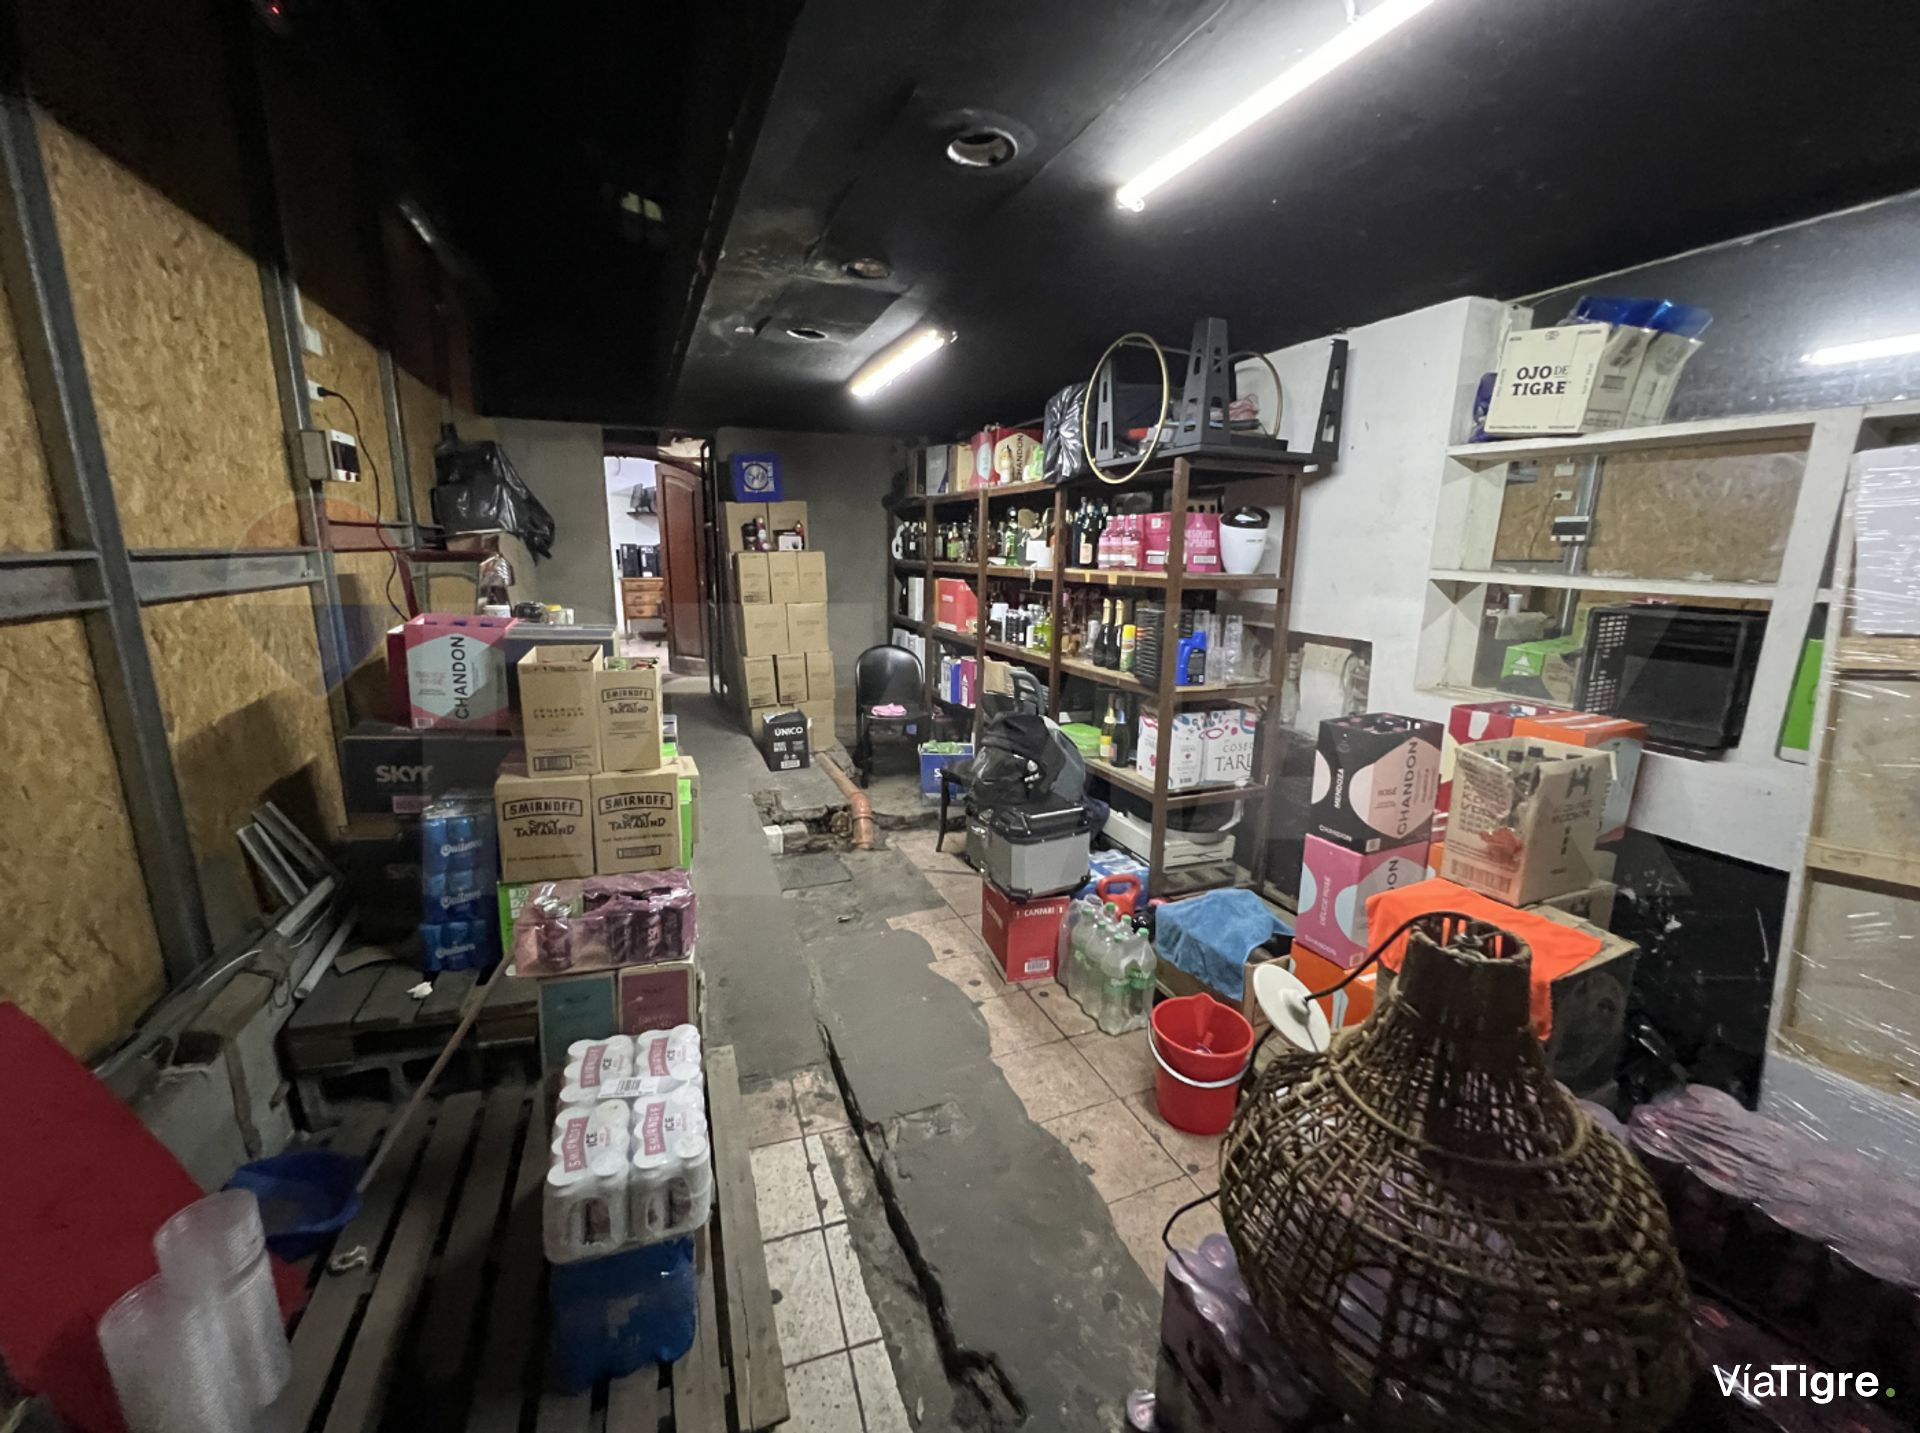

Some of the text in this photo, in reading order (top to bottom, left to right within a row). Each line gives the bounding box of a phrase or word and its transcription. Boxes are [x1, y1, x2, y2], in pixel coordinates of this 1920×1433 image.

[1516, 365, 1569, 380] OJO DE
[1512, 381, 1567, 396] TIGRE
[449, 636, 469, 720] CHANDON
[606, 689, 649, 699] SMIRNOFF
[376, 764, 433, 783] SKYY
[1333, 768, 1345, 809] MENDOZA
[1396, 740, 1418, 836] CHANDON
[509, 801, 576, 815] SMIRNOFF
[605, 794, 667, 810] SMIRNOFF
[1024, 906, 1055, 918] CAMPARI
[666, 1049, 676, 1061] ICE
[602, 1058, 612, 1070] ICE
[664, 1117, 675, 1131] ICE
[585, 1132, 598, 1147] ICE
